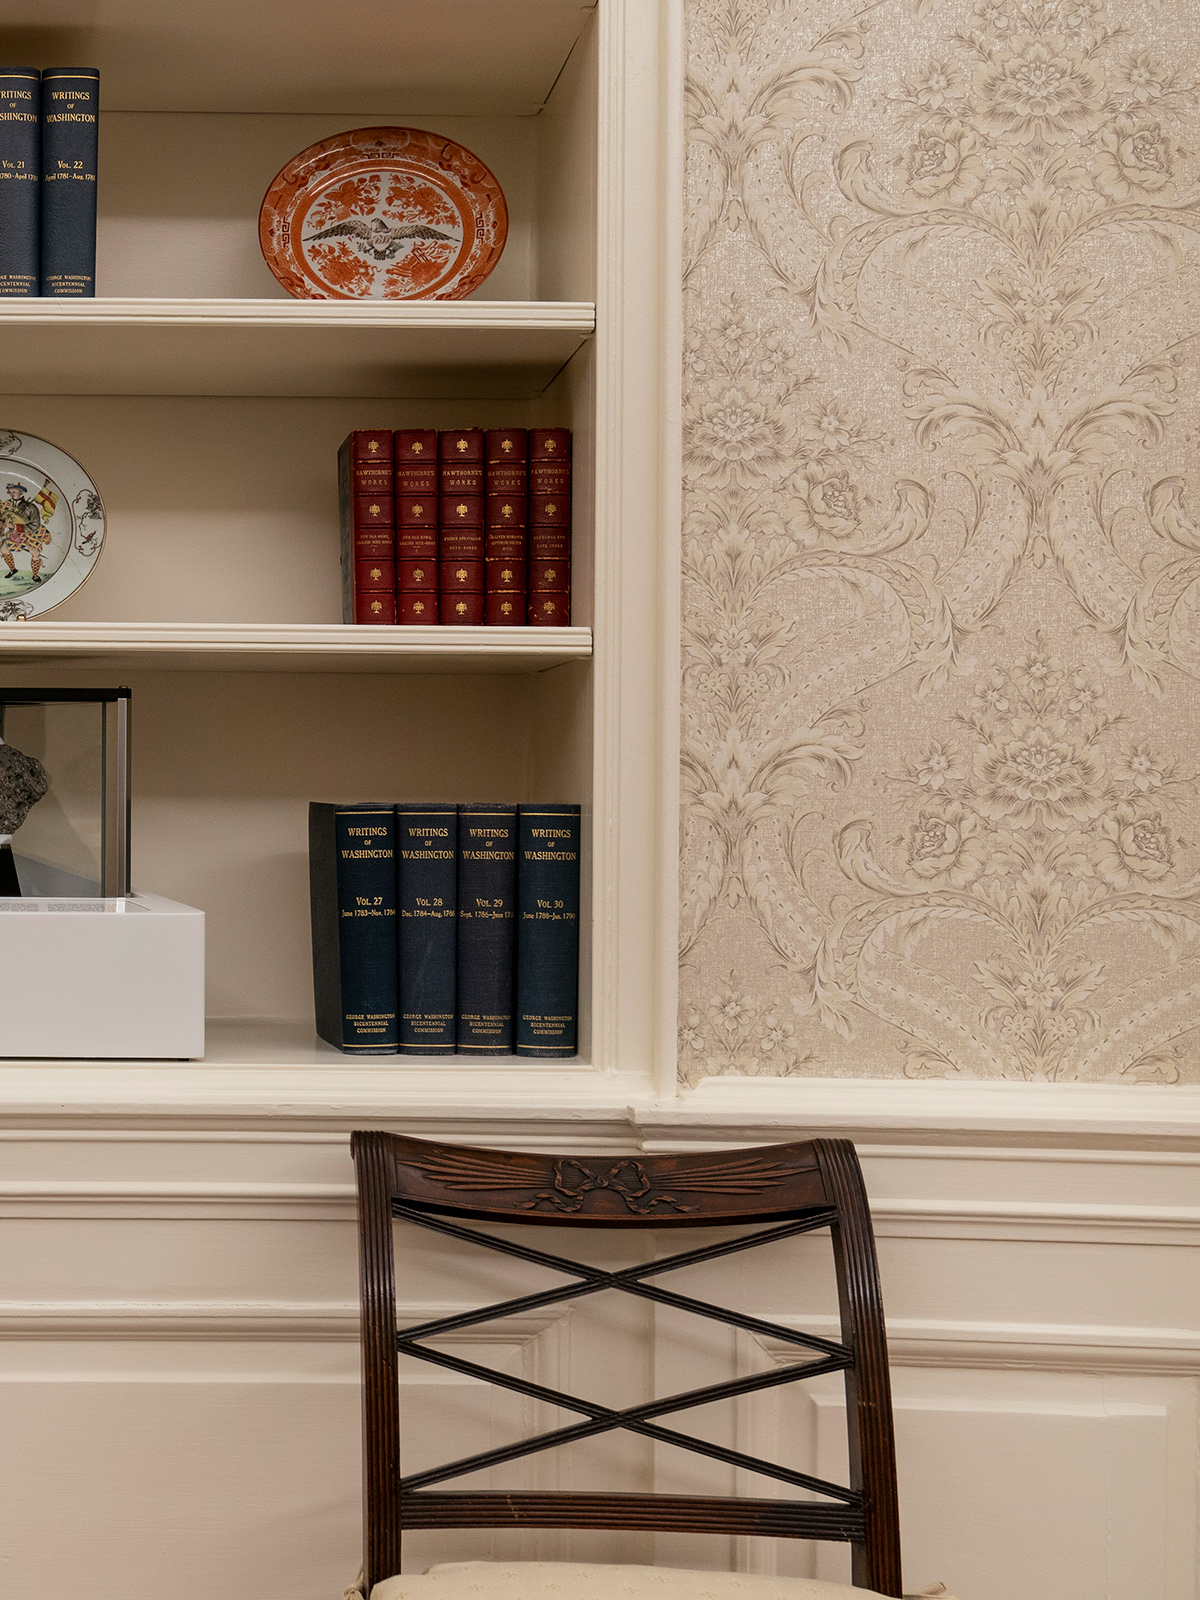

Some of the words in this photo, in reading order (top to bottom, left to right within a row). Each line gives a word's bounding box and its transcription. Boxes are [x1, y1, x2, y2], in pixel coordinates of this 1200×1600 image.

[52, 91, 90, 100] WRITINGS
[46, 113, 96, 123] WASHINGTON
[16, 160, 25, 169] 21
[73, 161, 83, 169] 22
[348, 827, 387, 837] WRITINGS
[408, 828, 448, 837] WRITINGS
[469, 828, 509, 838] WRITINGS
[532, 829, 571, 838] WRITINGS
[341, 849, 393, 859] WASHINGTON
[402, 850, 454, 859] WASHINGTON
[462, 851, 514, 860] WASHINGTON
[524, 851, 576, 861] WASHINGTON
[373, 897, 383, 905] 27
[433, 898, 443, 906] 28
[493, 899, 504, 907] 29
[553, 900, 564, 909] 30
